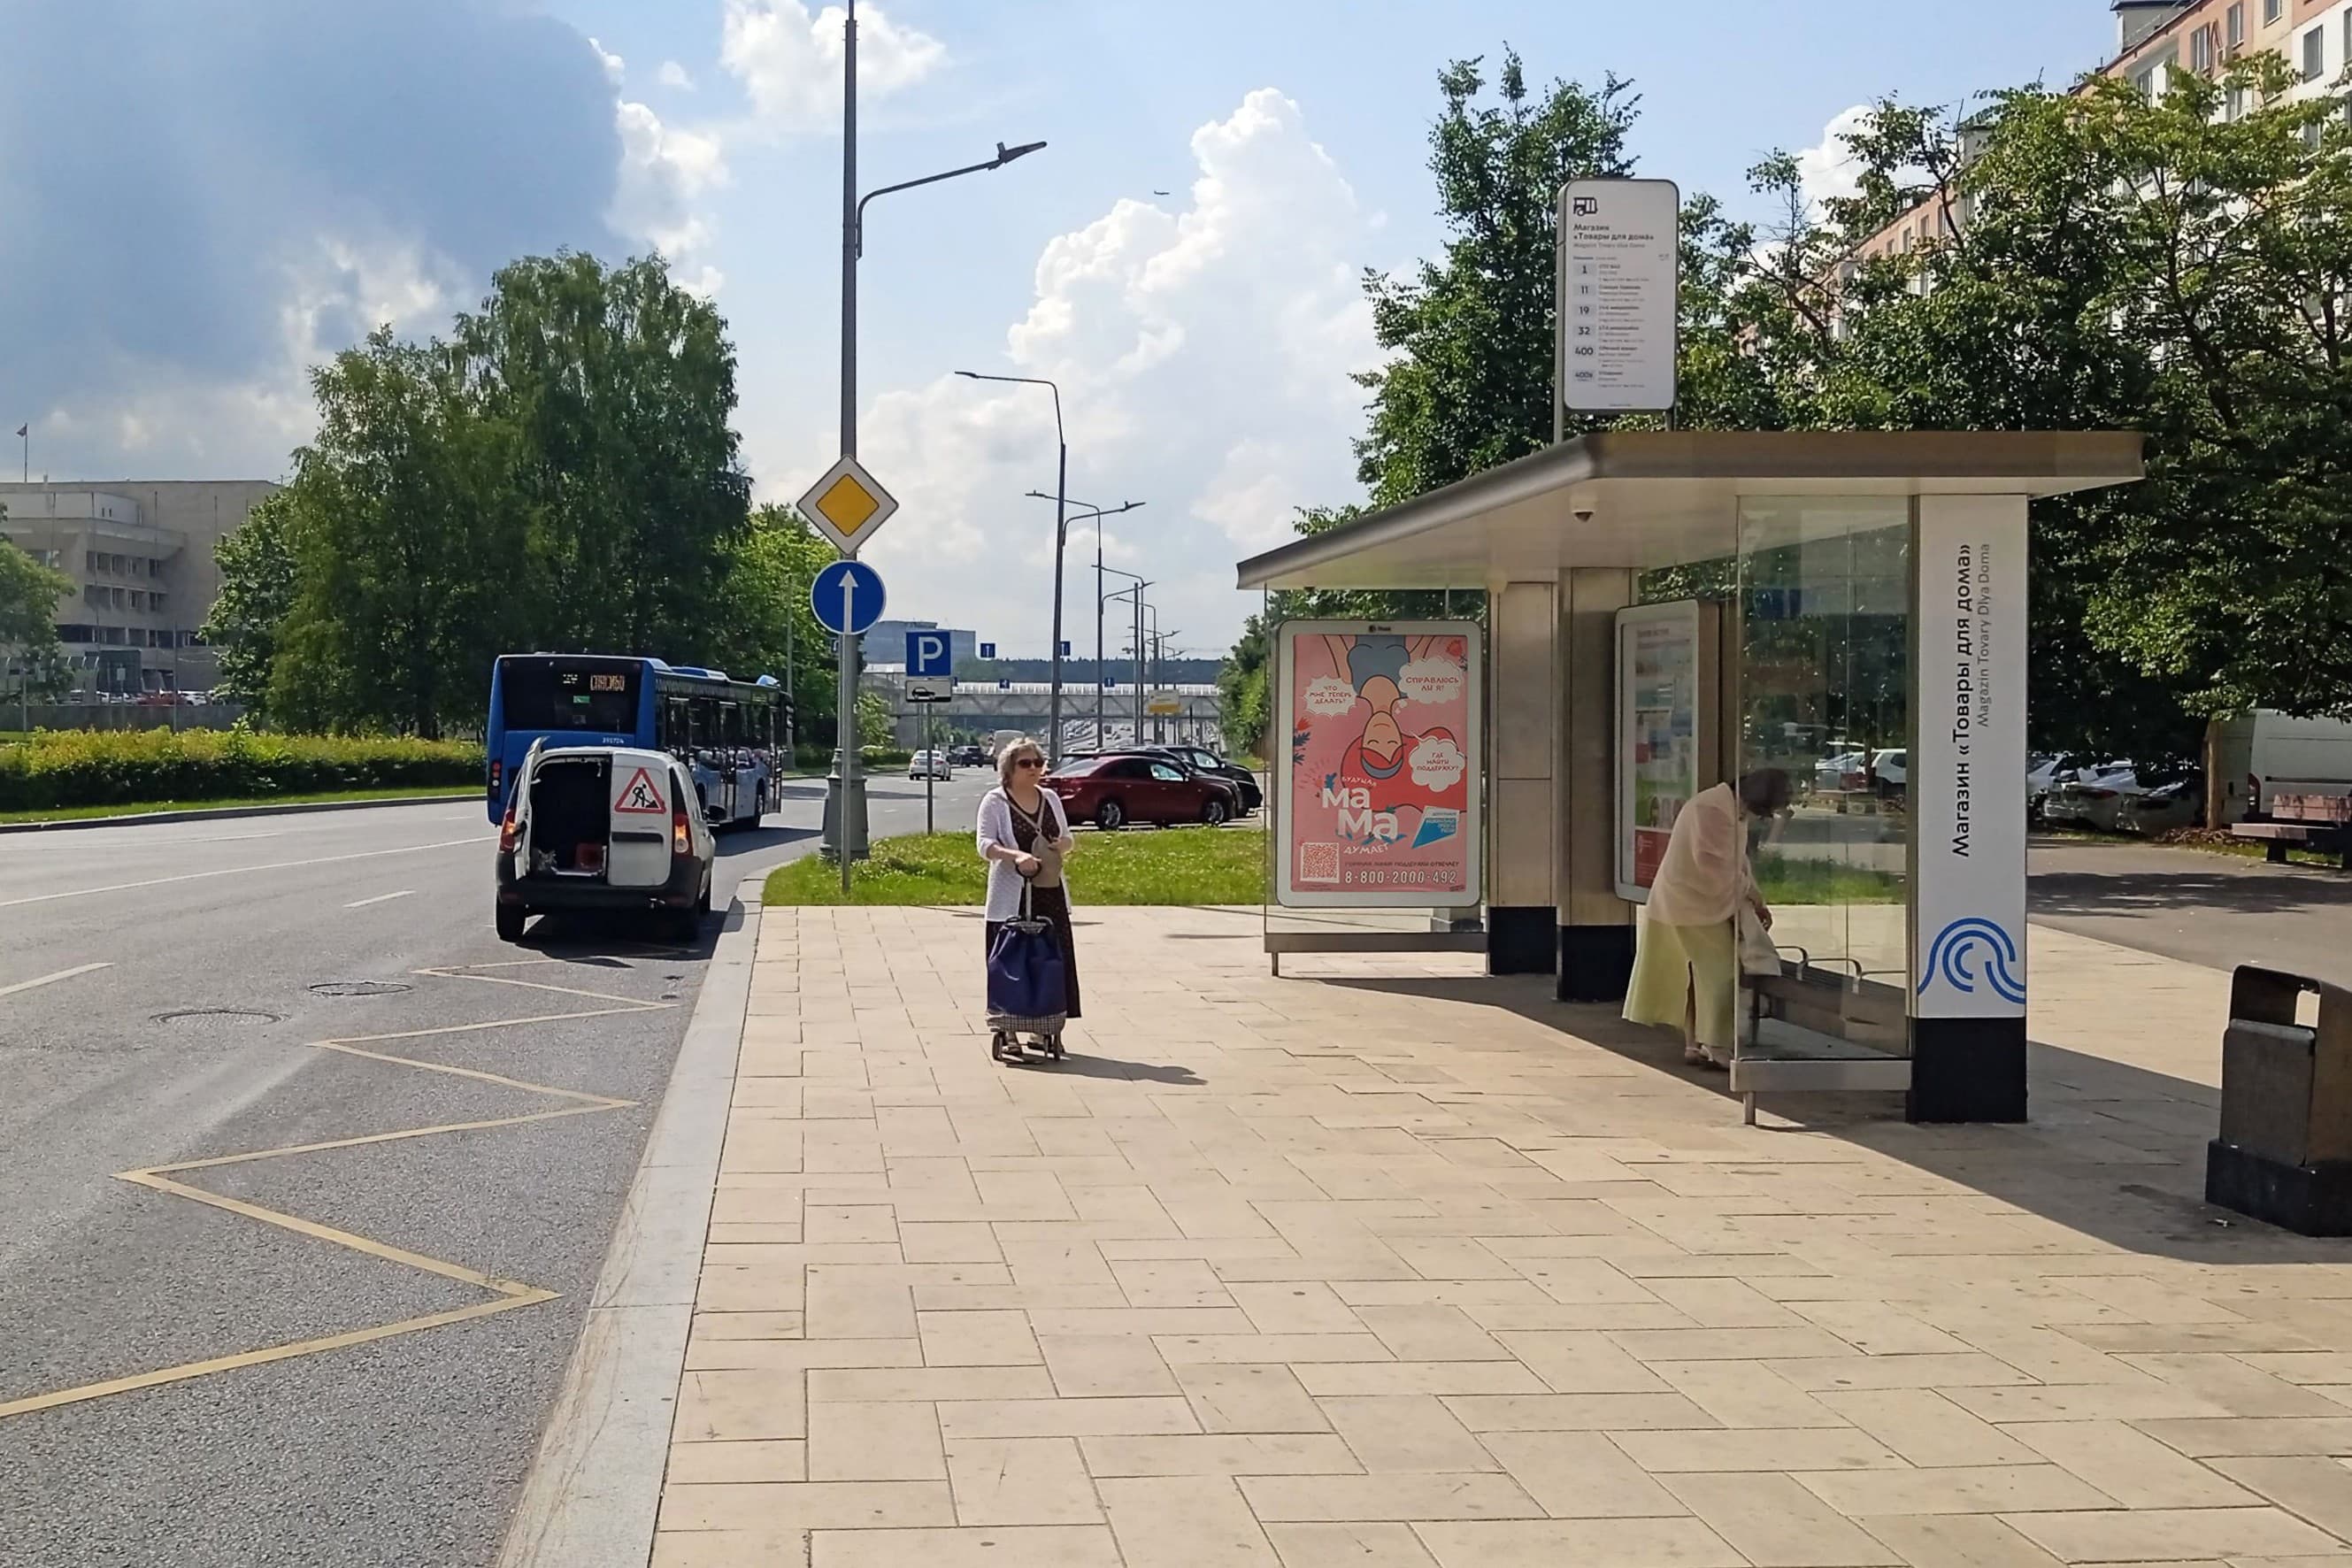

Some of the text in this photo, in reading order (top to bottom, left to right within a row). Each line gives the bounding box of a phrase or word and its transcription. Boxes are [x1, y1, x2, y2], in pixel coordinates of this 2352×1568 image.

[1582, 265, 1587, 274] 1
[1580, 285, 1589, 295] 11
[1579, 305, 1590, 315] 19
[1578, 326, 1590, 335] 32
[1574, 347, 1594, 356] 400
[1956, 544, 1973, 612] дома»
[1956, 619, 1973, 656] для
[1977, 543, 1992, 727] Magazin Tovary Dlya Doma
[919, 636, 943, 673] P
[1952, 763, 1970, 857] Магазин
[1343, 842, 1389, 855] ДУМАЕТ
